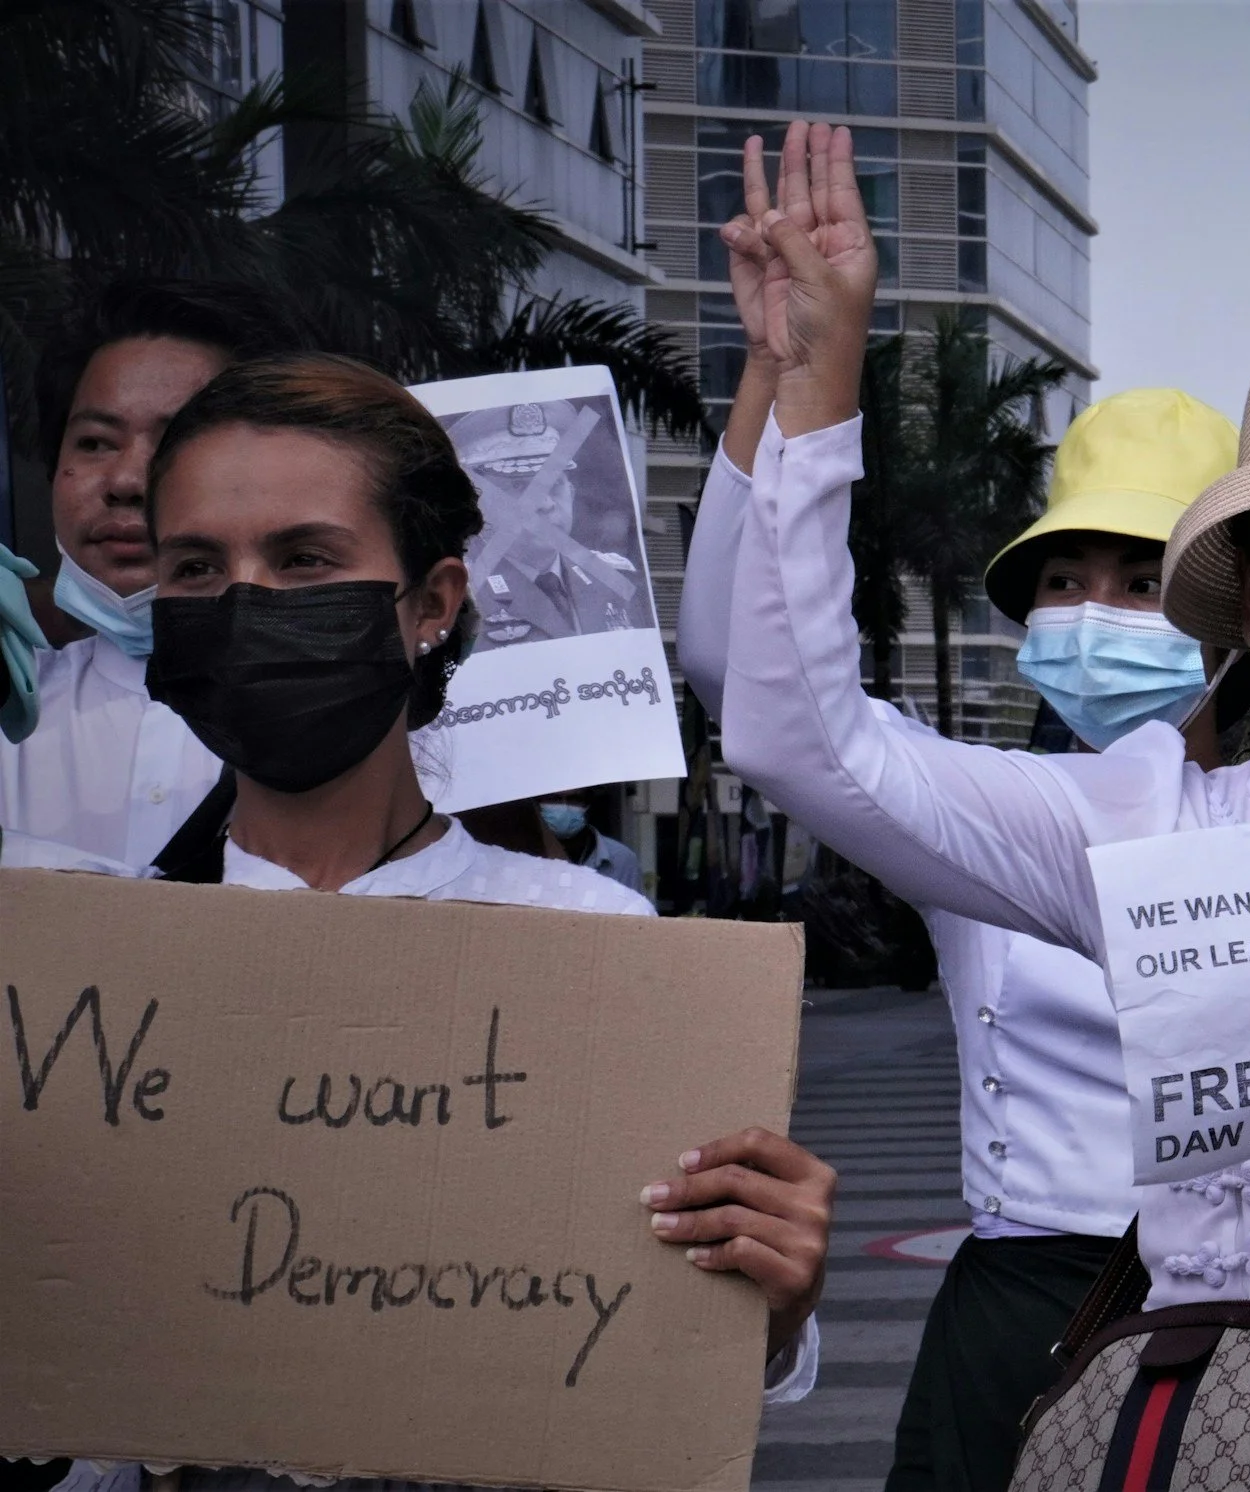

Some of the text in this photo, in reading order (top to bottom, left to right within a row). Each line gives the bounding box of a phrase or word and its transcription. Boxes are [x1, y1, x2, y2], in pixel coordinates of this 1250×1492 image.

[1127, 901, 1178, 930] WE
[1136, 948, 1203, 978] OUR
[6, 984, 528, 1130] We want
[1156, 1121, 1244, 1163] DAW
[203, 1185, 632, 1388] Democracy
